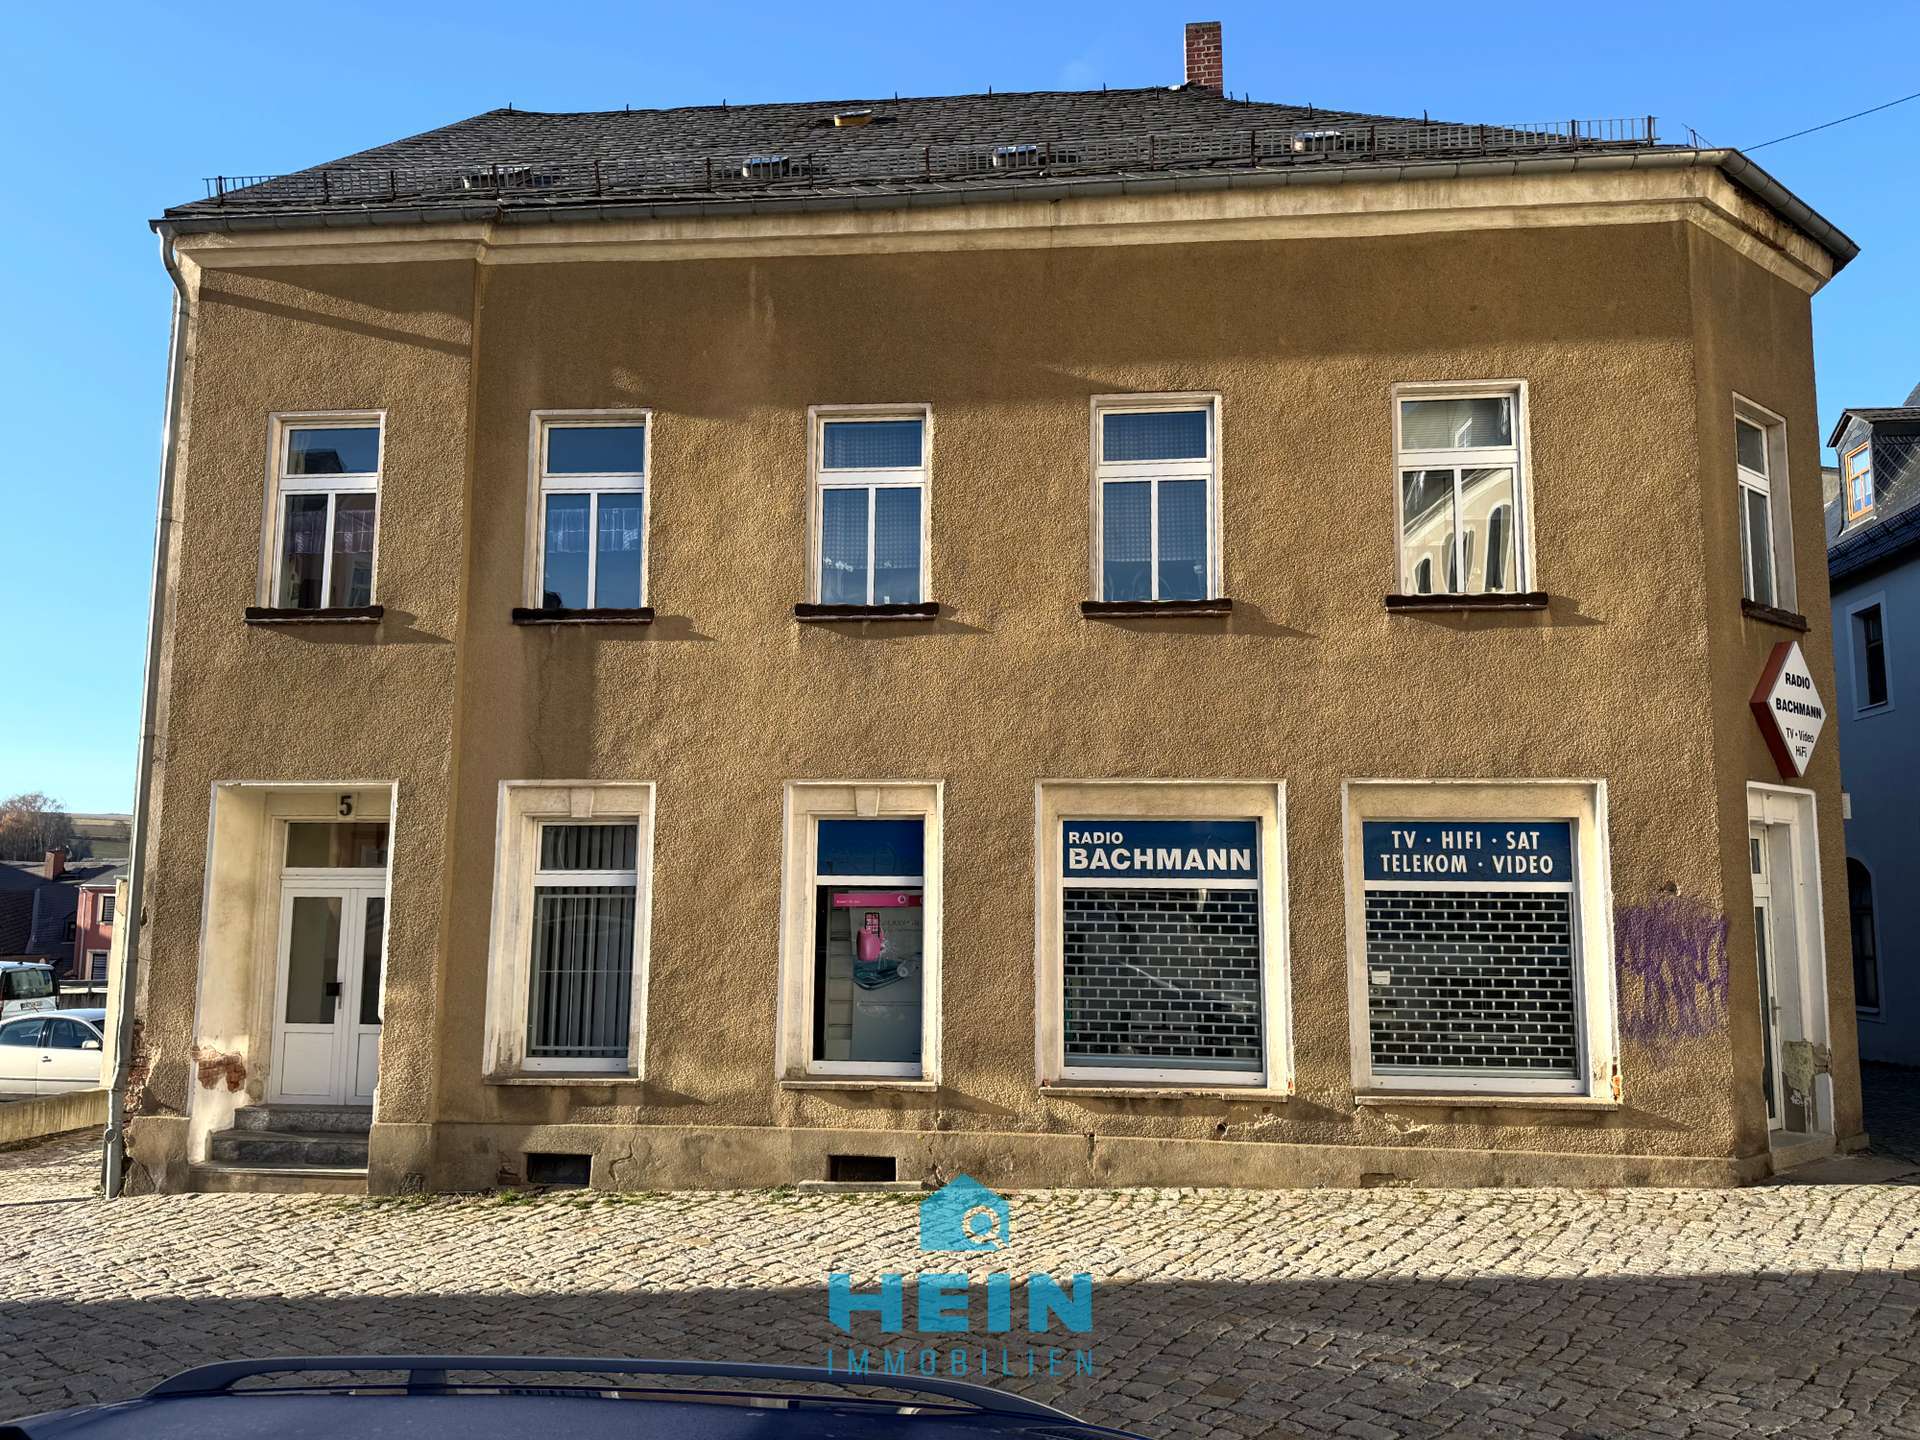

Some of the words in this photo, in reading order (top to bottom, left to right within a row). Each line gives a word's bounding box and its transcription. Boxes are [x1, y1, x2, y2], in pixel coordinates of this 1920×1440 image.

[1785, 672, 1810, 690] RADIO
[1775, 697, 1822, 720] BACHMANN
[1786, 727, 1794, 739] TV
[1798, 729, 1815, 744] Video
[1795, 745, 1808, 758] HiFi
[339, 795, 353, 816] 5
[1068, 831, 1124, 845] RADIO
[1391, 830, 1417, 849] TV
[1441, 831, 1482, 849] HIFI
[1506, 831, 1540, 850] SAT
[1068, 848, 1251, 871] BACHMANN
[1380, 854, 1468, 873] TELEKOM
[1492, 855, 1554, 874] VIDEO
